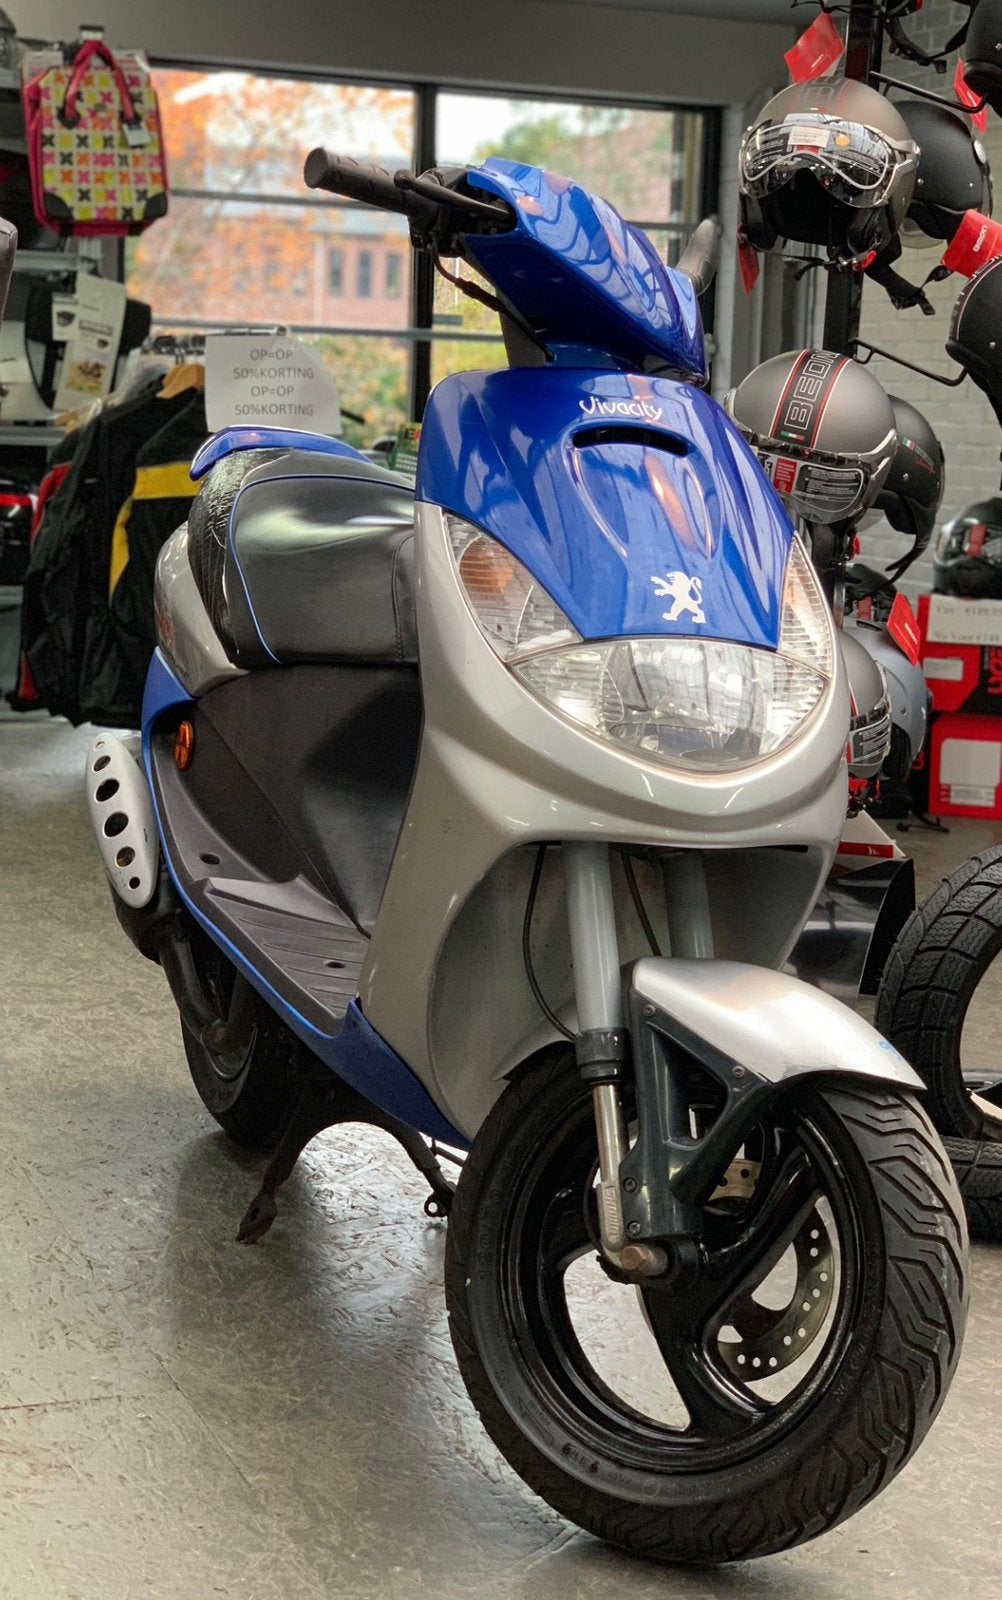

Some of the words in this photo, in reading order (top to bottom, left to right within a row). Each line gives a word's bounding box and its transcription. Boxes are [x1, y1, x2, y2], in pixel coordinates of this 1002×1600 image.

[250, 349, 293, 361] OP=OP
[250, 386, 294, 397] OP=OP
[784, 350, 840, 430] BEON
[579, 396, 663, 423] Vivacity
